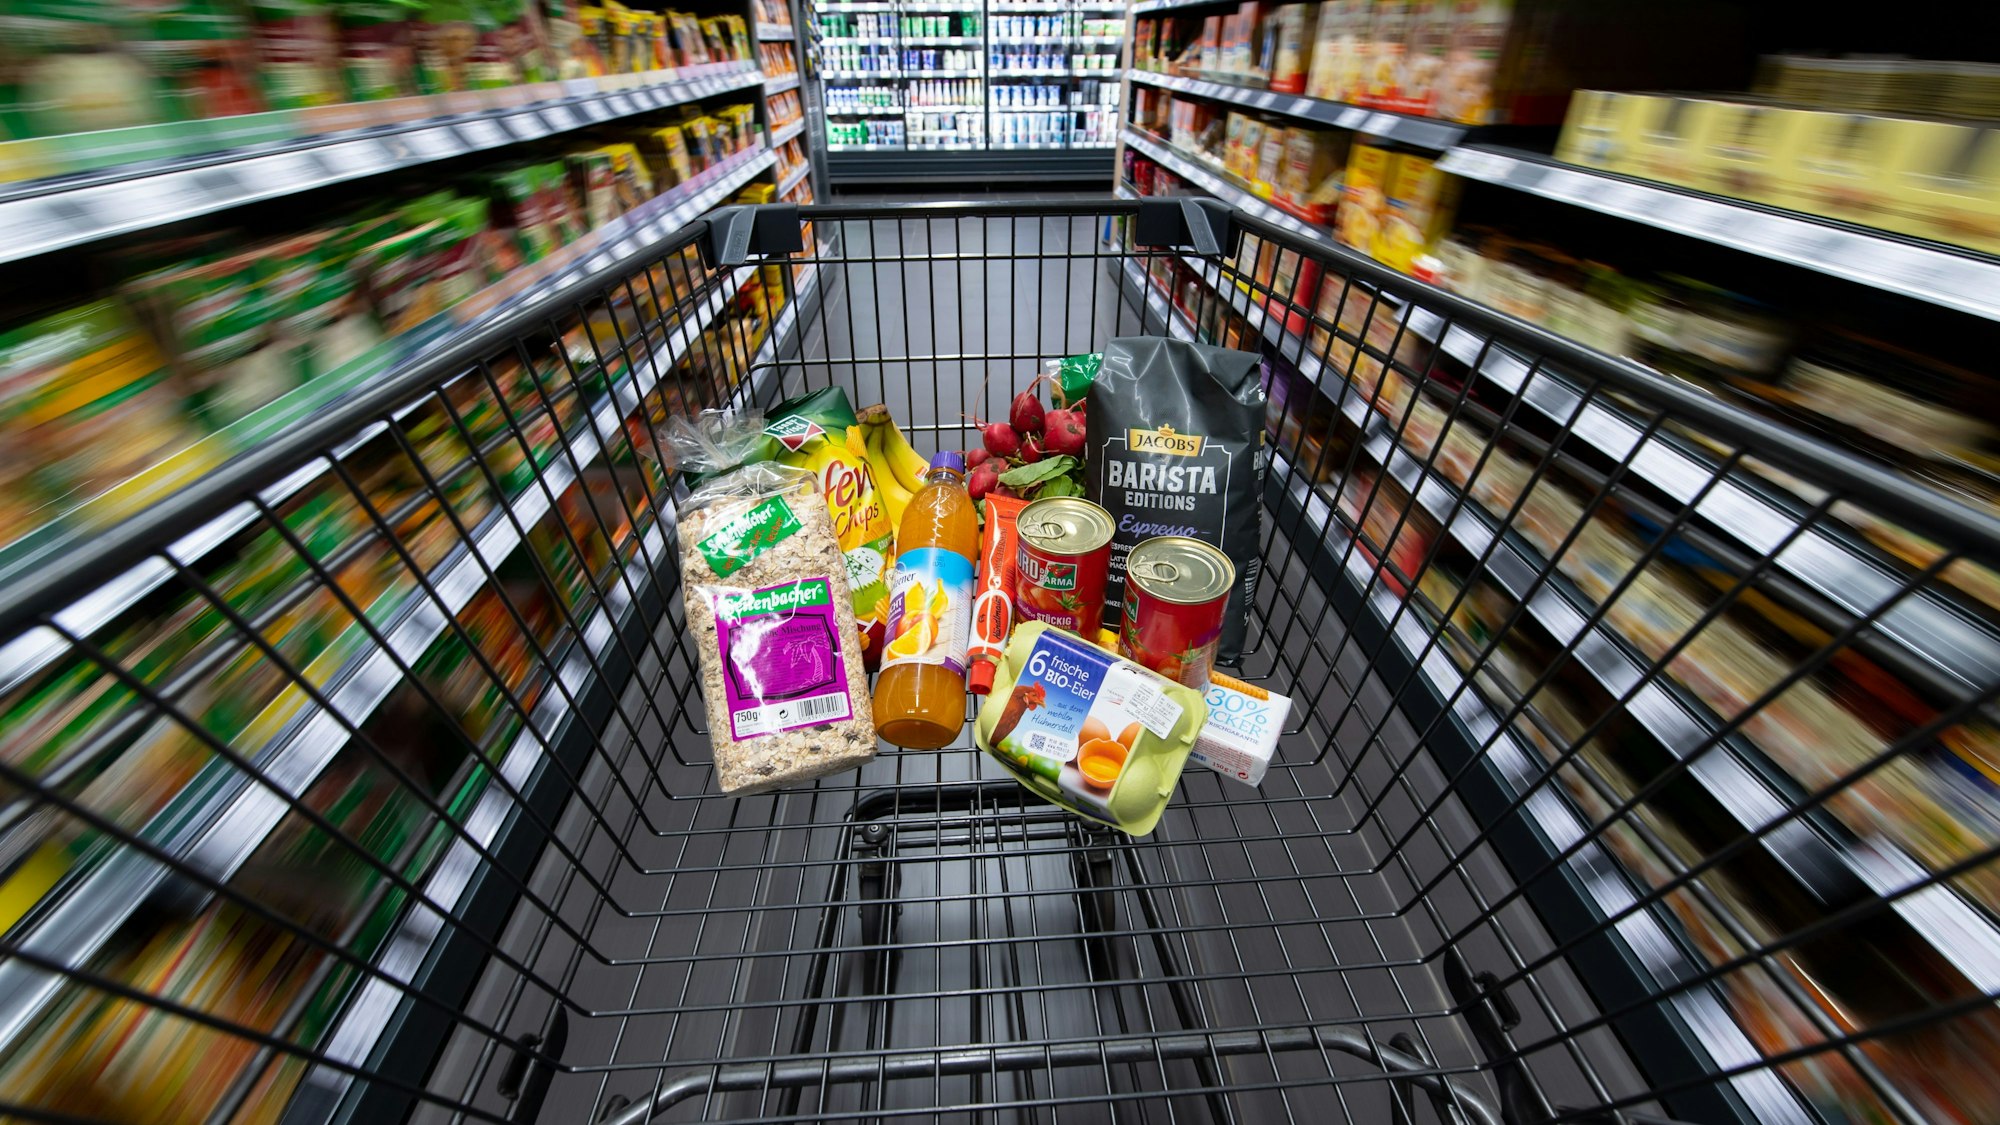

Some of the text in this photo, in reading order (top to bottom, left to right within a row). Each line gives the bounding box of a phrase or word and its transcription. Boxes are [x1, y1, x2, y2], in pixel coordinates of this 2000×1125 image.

[1134, 434, 1196, 452] JACOBS
[824, 459, 875, 508] fen
[1108, 460, 1217, 494] BARISTA
[1125, 491, 1196, 511] EDITIONS
[835, 501, 880, 537] Chips
[1117, 514, 1198, 538] Espresso
[1110, 542, 1135, 552] ESPRES
[1039, 574, 1074, 586] PARMA
[1036, 612, 1072, 626] STÜCKIG
[1029, 650, 1051, 677] 6
[1050, 655, 1090, 682] frische
[1045, 668, 1095, 701] BIO-Eier
[1206, 688, 1270, 725] 30%
[1208, 721, 1260, 745] RISCHGARANTIE
